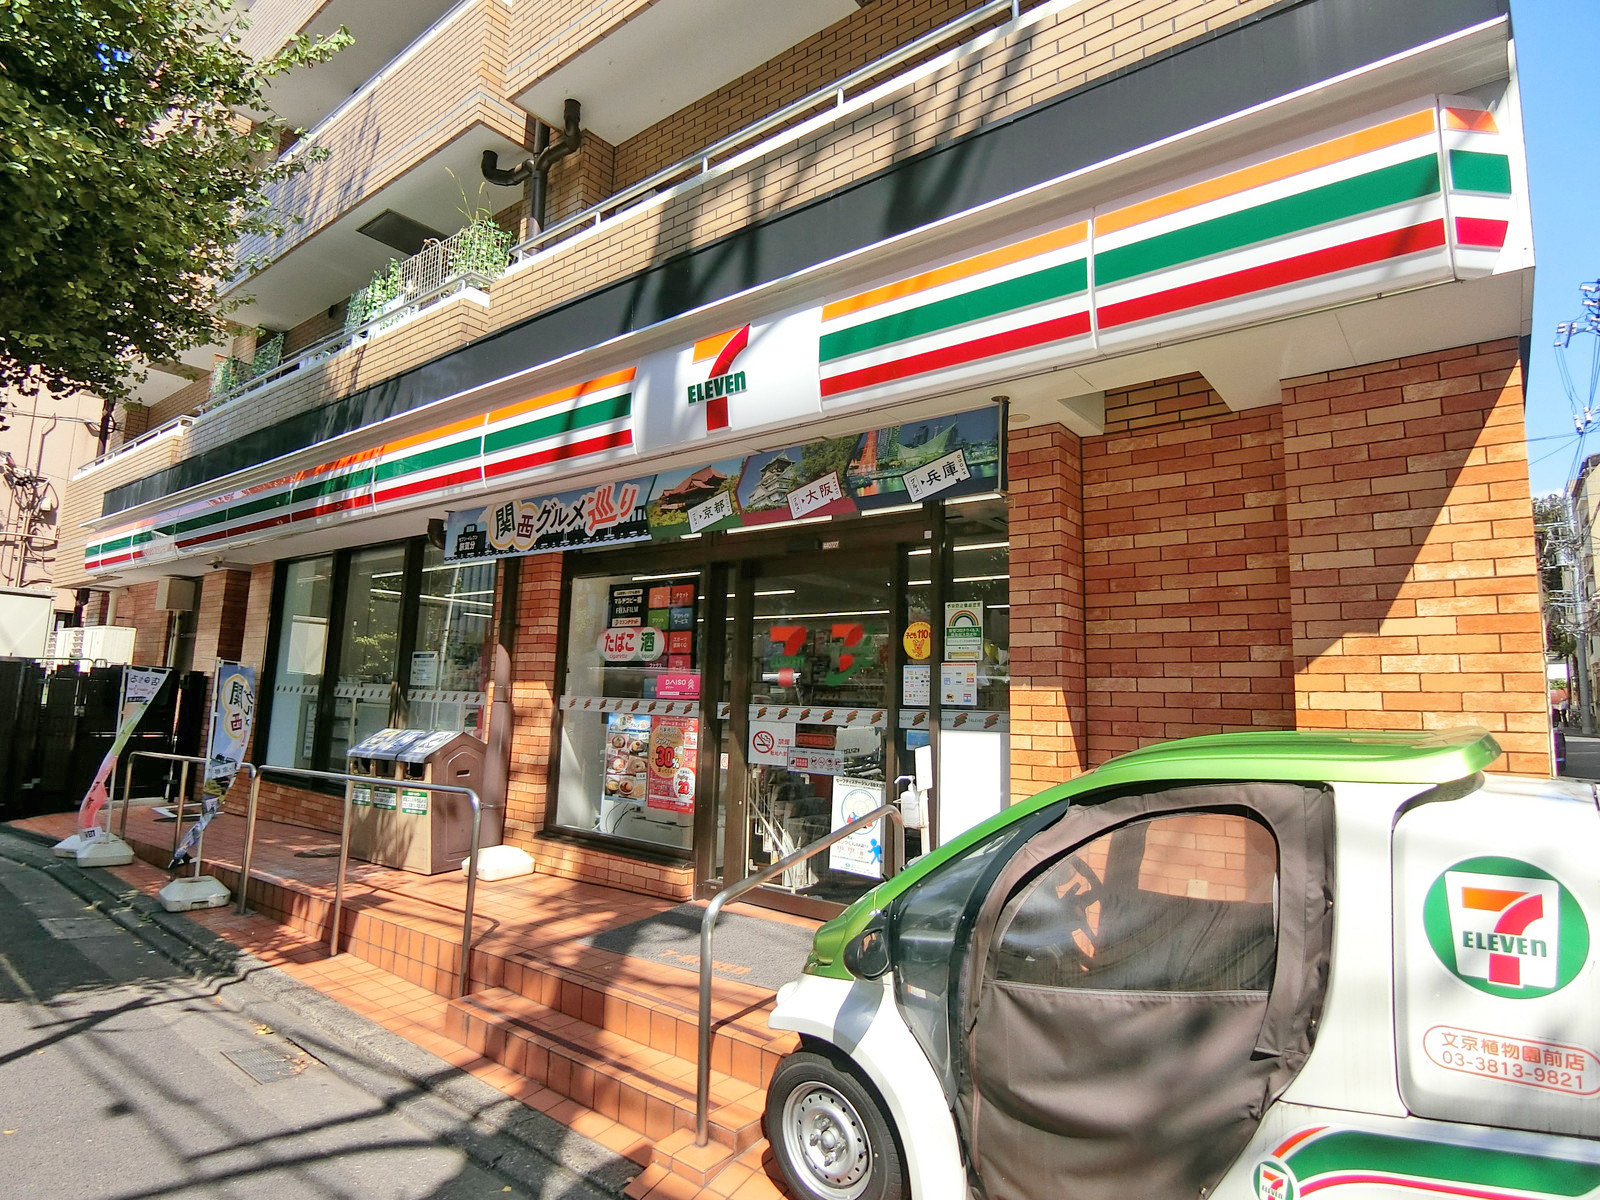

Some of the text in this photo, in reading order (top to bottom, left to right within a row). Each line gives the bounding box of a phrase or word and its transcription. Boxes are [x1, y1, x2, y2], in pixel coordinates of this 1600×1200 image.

[693, 323, 750, 432] 7
[926, 461, 958, 486] 兵庫
[805, 482, 834, 504] 大阪
[495, 485, 637, 540] 関西グルメ巡り
[702, 500, 726, 519] 京都
[604, 632, 635, 653] たばこ
[640, 632, 656, 652] 酒
[905, 629, 931, 639] 子ども110
[1461, 886, 1544, 986] 7
[1442, 1031, 1586, 1072] 文京植物園前店
[1442, 1051, 1584, 1090] 03-3813-9821
